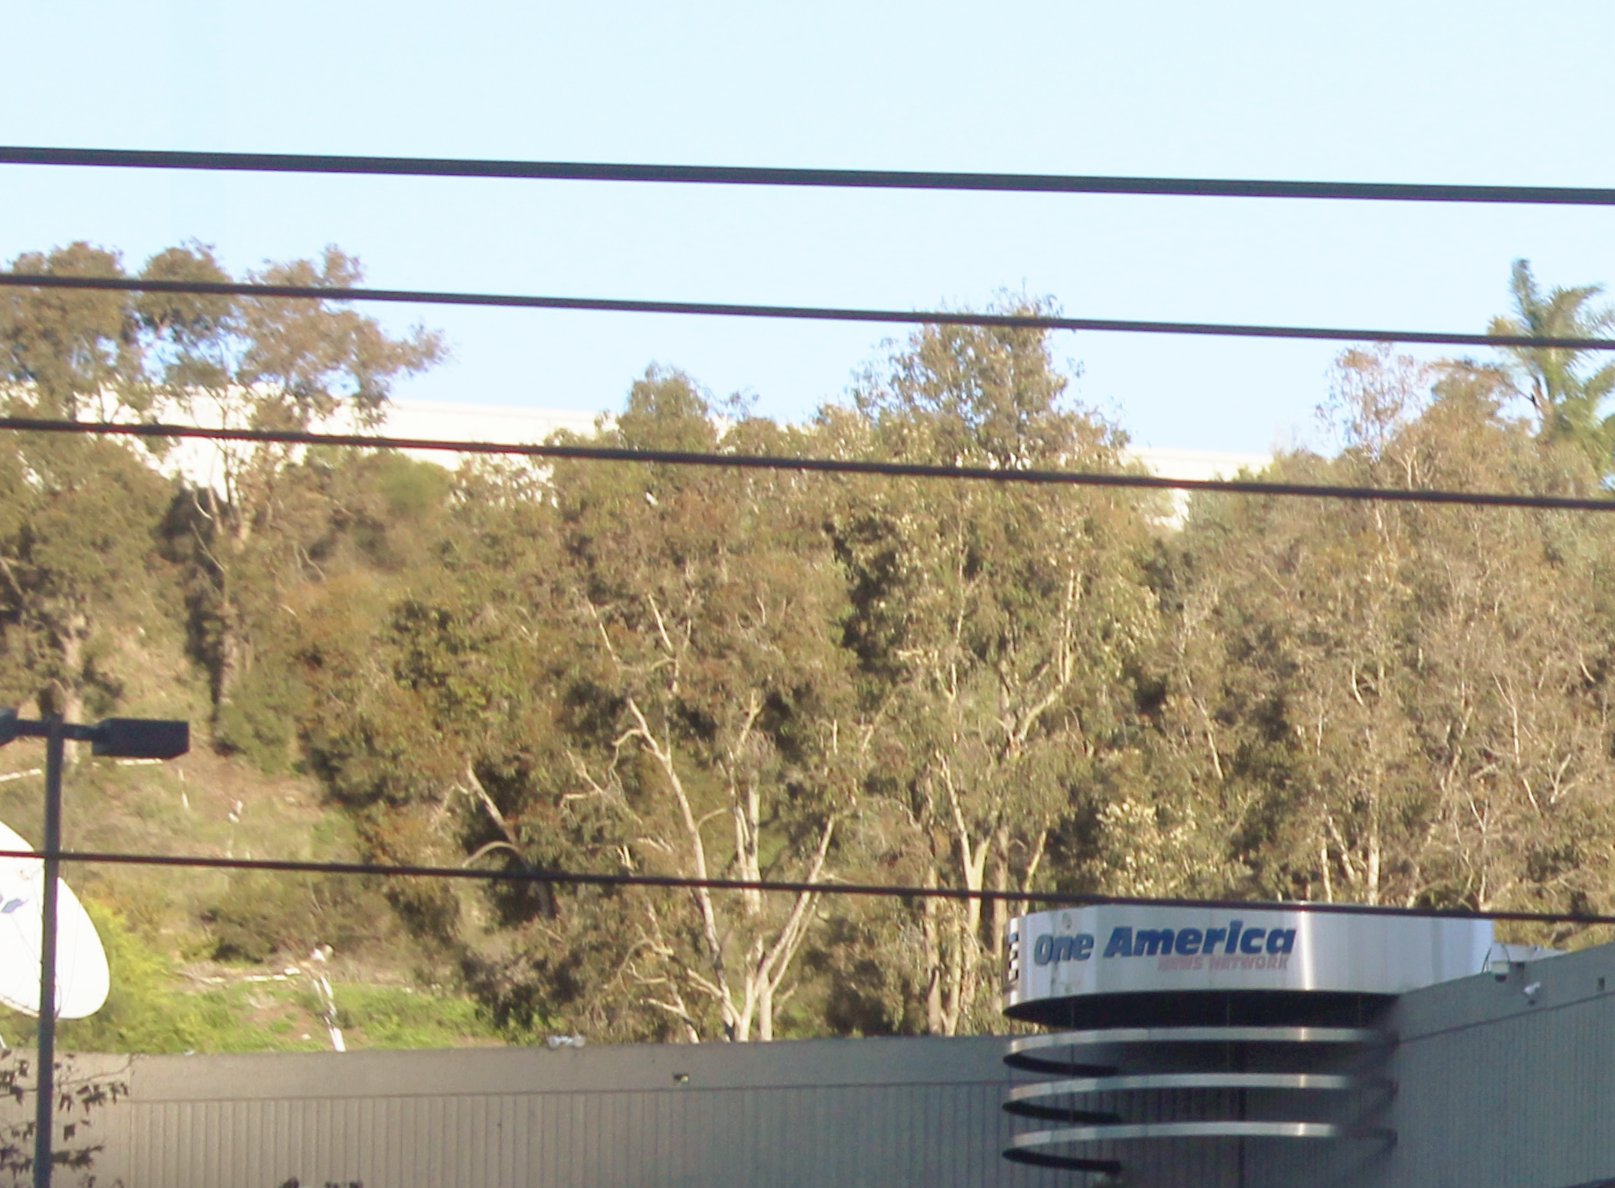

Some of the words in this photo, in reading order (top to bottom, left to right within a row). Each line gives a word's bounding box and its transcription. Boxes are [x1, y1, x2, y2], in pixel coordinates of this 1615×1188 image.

[1034, 932, 1095, 966] One
[1102, 919, 1297, 958] America
[1157, 954, 1205, 971] NEWS
[1209, 954, 1291, 971] NETWORK
